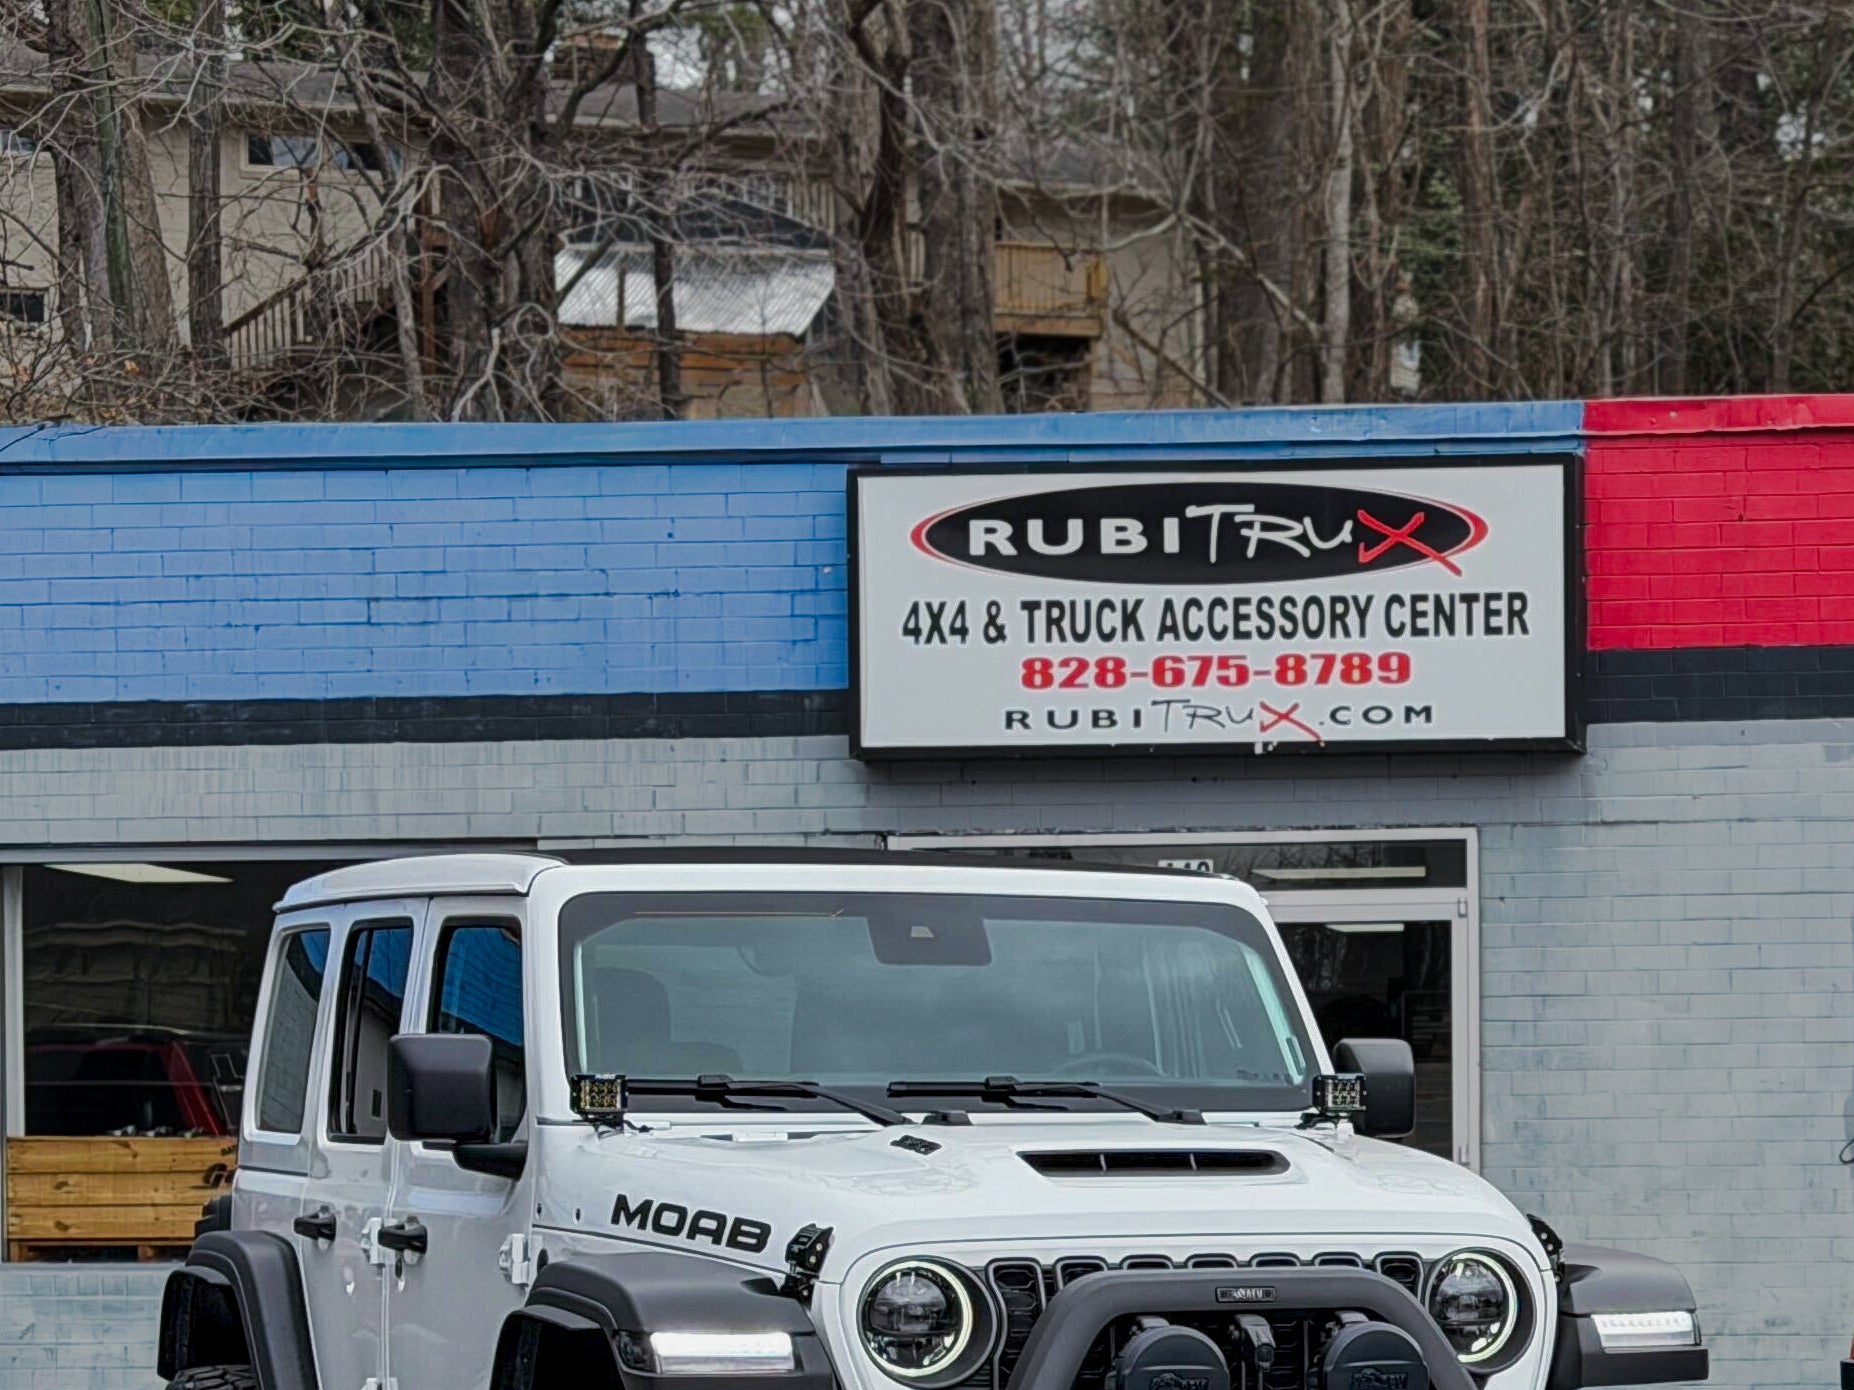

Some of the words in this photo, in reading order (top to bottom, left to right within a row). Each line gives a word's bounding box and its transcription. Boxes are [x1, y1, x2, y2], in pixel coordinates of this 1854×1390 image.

[902, 601, 969, 645] 4X4
[984, 603, 1006, 643] &
[1020, 598, 1146, 643] TRUCK
[1156, 594, 1373, 641] ACCESSORY
[1384, 591, 1530, 637] CENTER
[1020, 652, 1411, 689] 828-675-8789
[611, 1193, 772, 1253] MOAB
